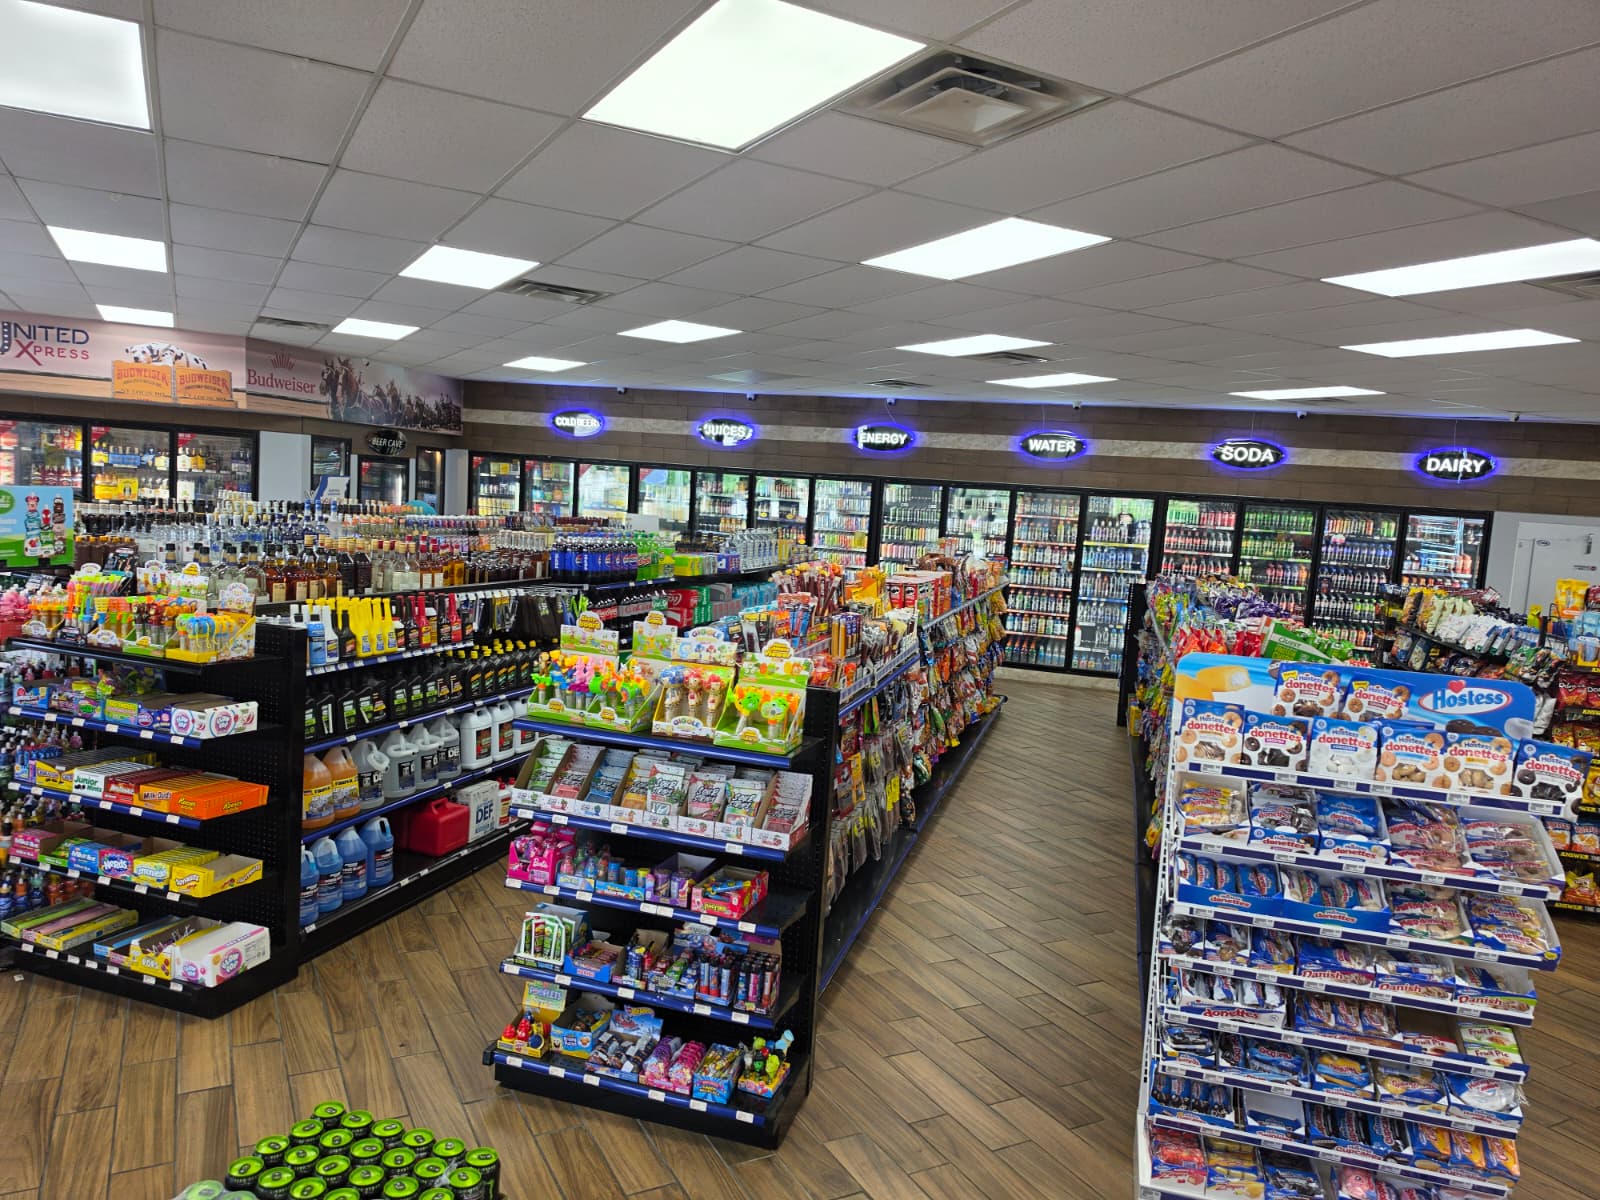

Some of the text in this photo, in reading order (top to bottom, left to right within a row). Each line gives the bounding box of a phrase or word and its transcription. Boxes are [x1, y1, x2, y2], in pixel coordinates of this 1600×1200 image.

[14, 339, 89, 366] XPRESS
[117, 367, 169, 386] BUDWEISER
[179, 373, 230, 393] BUDWEISER
[247, 368, 316, 394] Budweiser
[555, 416, 576, 427] COLD
[704, 422, 746, 438] JUICES
[860, 430, 908, 445] ENERGY
[371, 437, 388, 448] BEER
[1028, 438, 1076, 453] WATER
[1221, 446, 1275, 463] SODA
[1426, 457, 1486, 474] DAIRY
[1285, 680, 1335, 694] donettes
[1355, 690, 1404, 708] donettes
[1433, 688, 1504, 710] Hostess
[1187, 721, 1236, 734] donettes
[1251, 729, 1302, 743] donettes
[1318, 734, 1372, 749] donettes
[1385, 742, 1439, 757] donettes
[1450, 746, 1507, 762] donettes
[1525, 760, 1583, 780] donettes
[75, 775, 98, 786] Junior
[476, 803, 493, 824] DEF
[1301, 970, 1343, 980] Danish
[1378, 983, 1422, 994] Danish
[1458, 995, 1502, 1006] Danish
[1203, 1008, 1259, 1019] donettes
[1468, 1027, 1502, 1036] Fruit Pie
[1411, 1037, 1445, 1047] Fruit Pie
[1475, 1049, 1510, 1058] Fruit Pie
